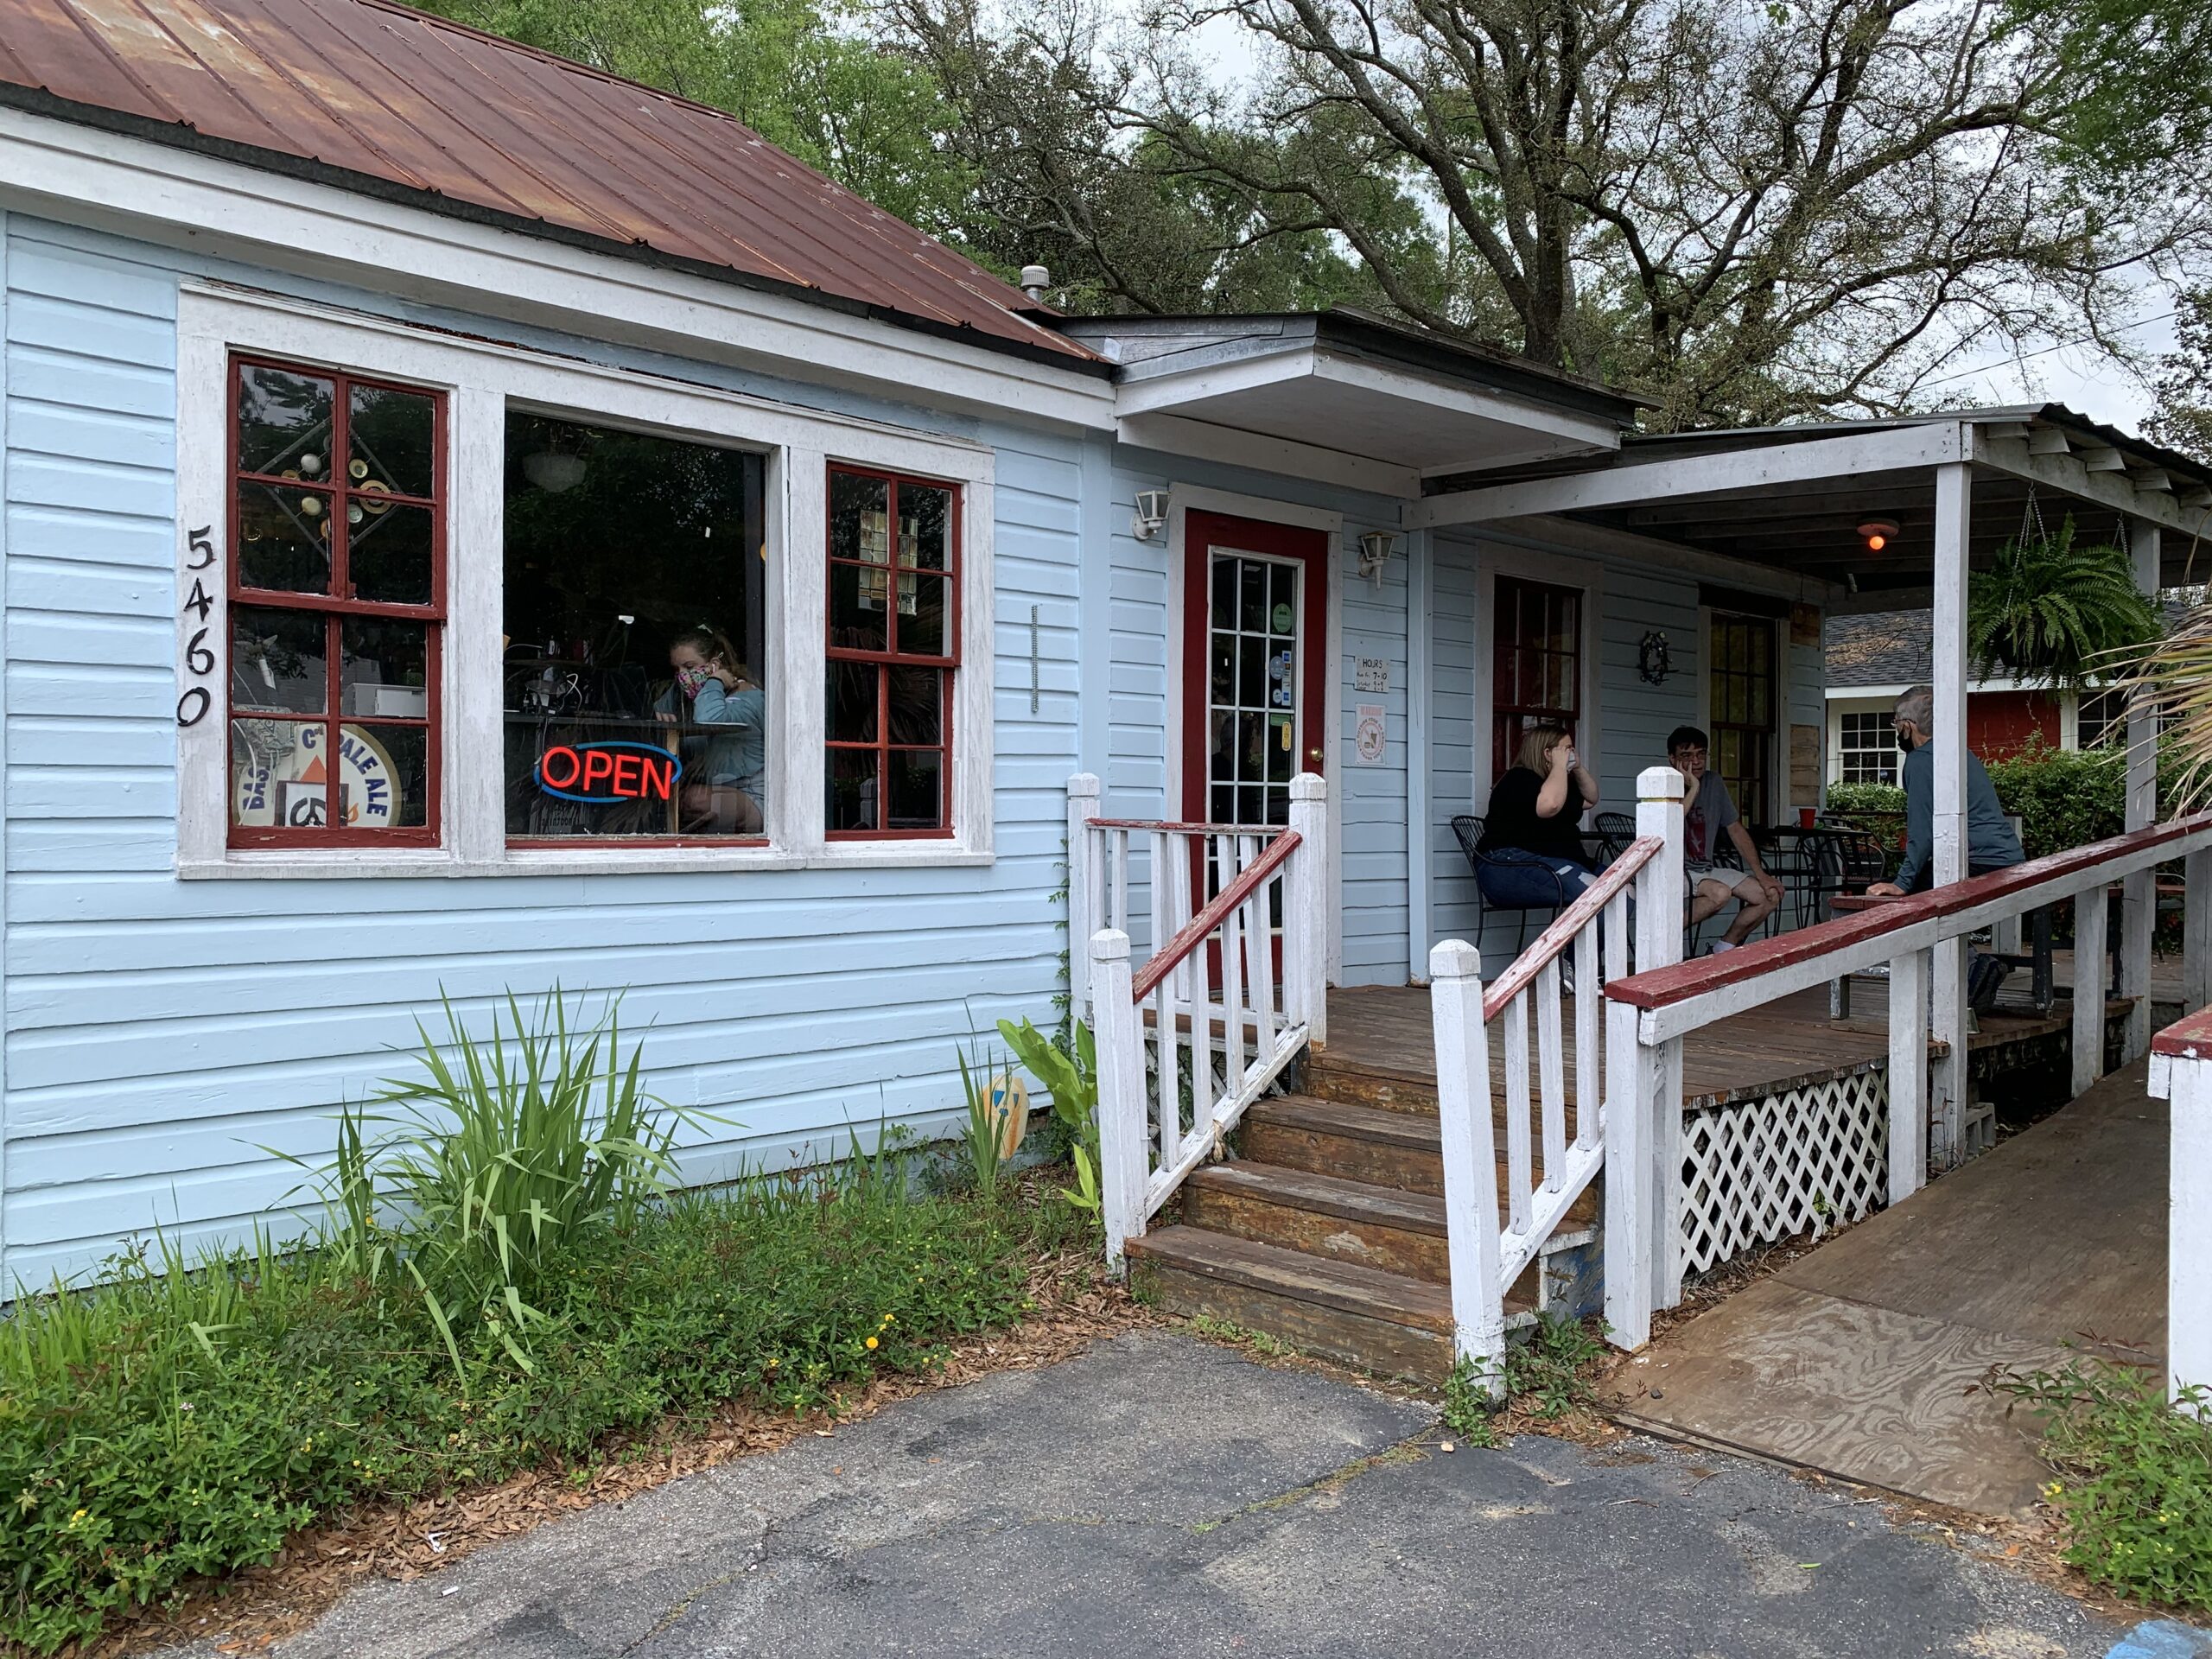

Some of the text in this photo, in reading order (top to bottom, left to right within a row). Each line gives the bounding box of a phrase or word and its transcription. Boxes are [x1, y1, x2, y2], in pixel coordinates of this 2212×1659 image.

[177, 524, 215, 728] 5460
[243, 763, 271, 810] BAS
[365, 779, 388, 817] ALE
[543, 746, 672, 800] OPEN
